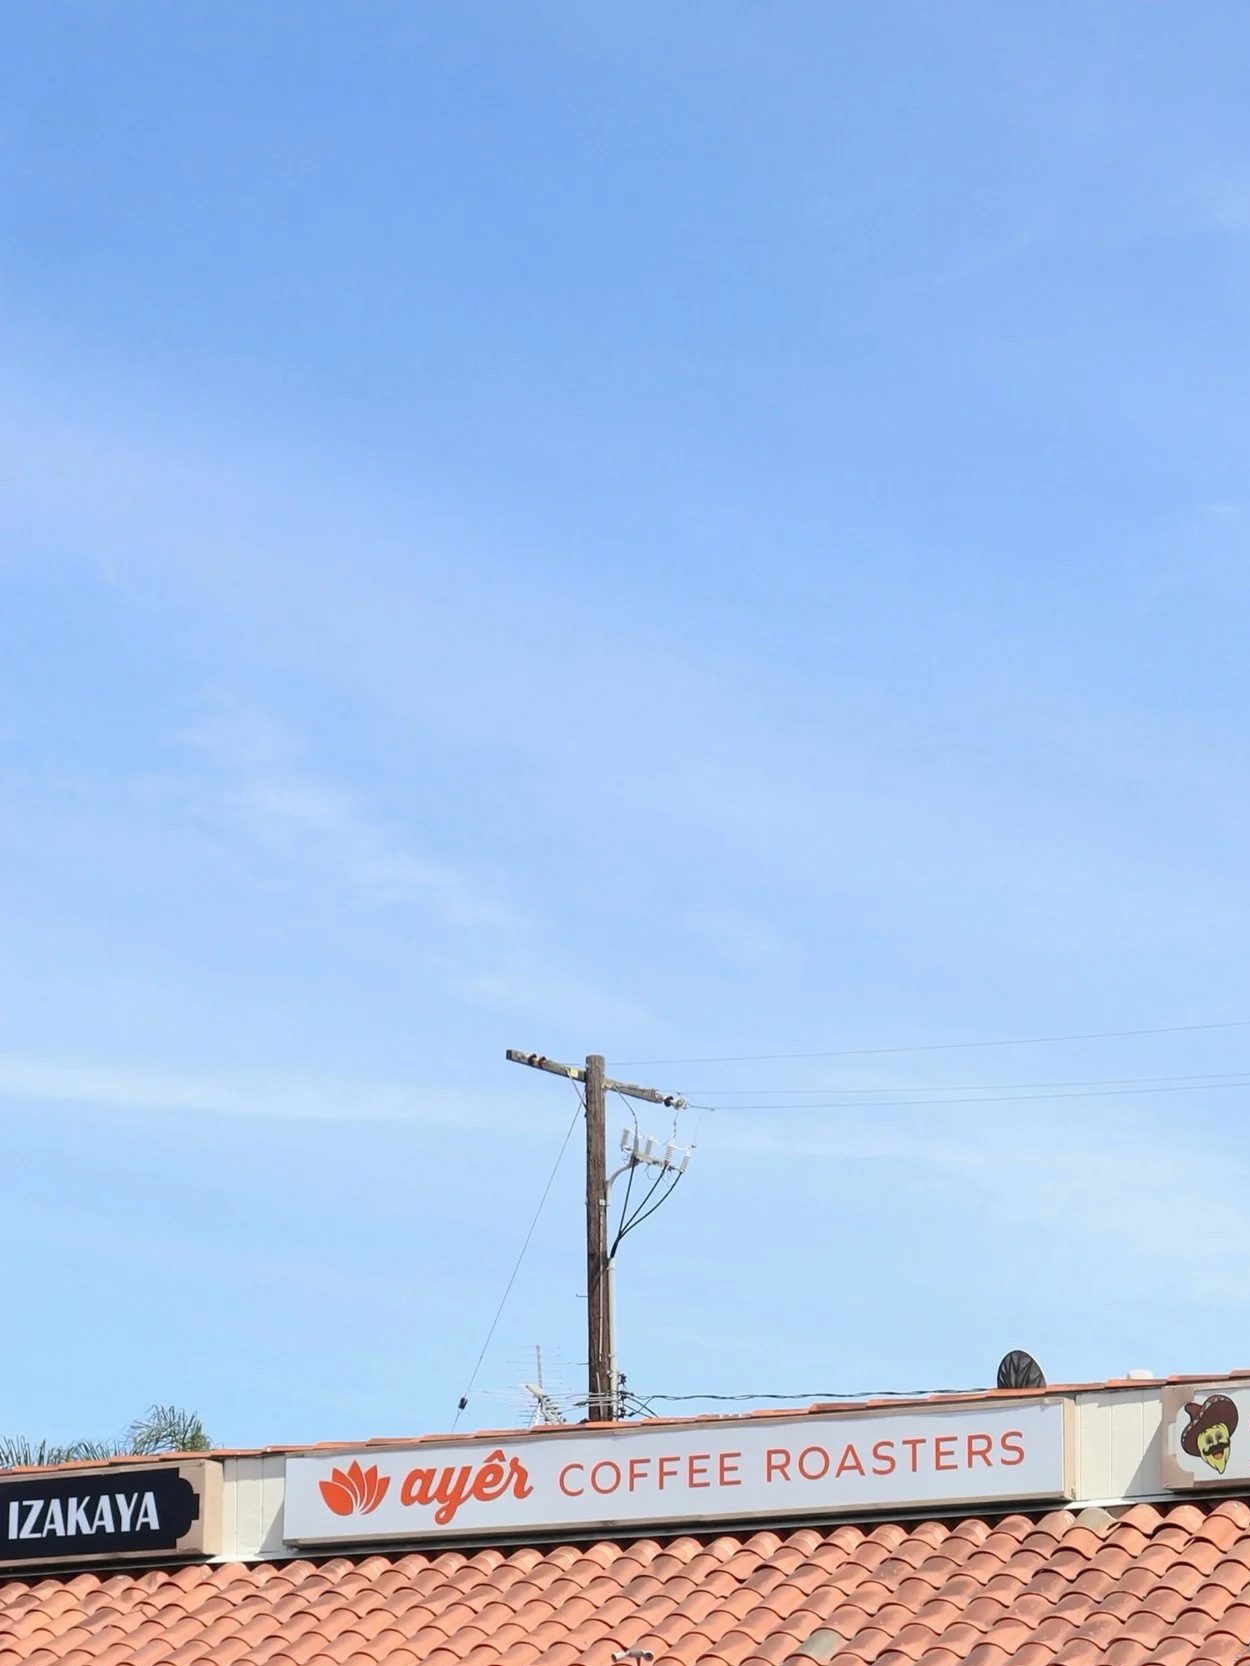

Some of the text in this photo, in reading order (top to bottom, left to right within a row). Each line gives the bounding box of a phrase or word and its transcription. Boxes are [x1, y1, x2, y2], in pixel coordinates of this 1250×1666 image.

[400, 1431, 1026, 1525] ayêr COFFEE ROASTERS
[8, 1491, 160, 1540] IZAKAYA
